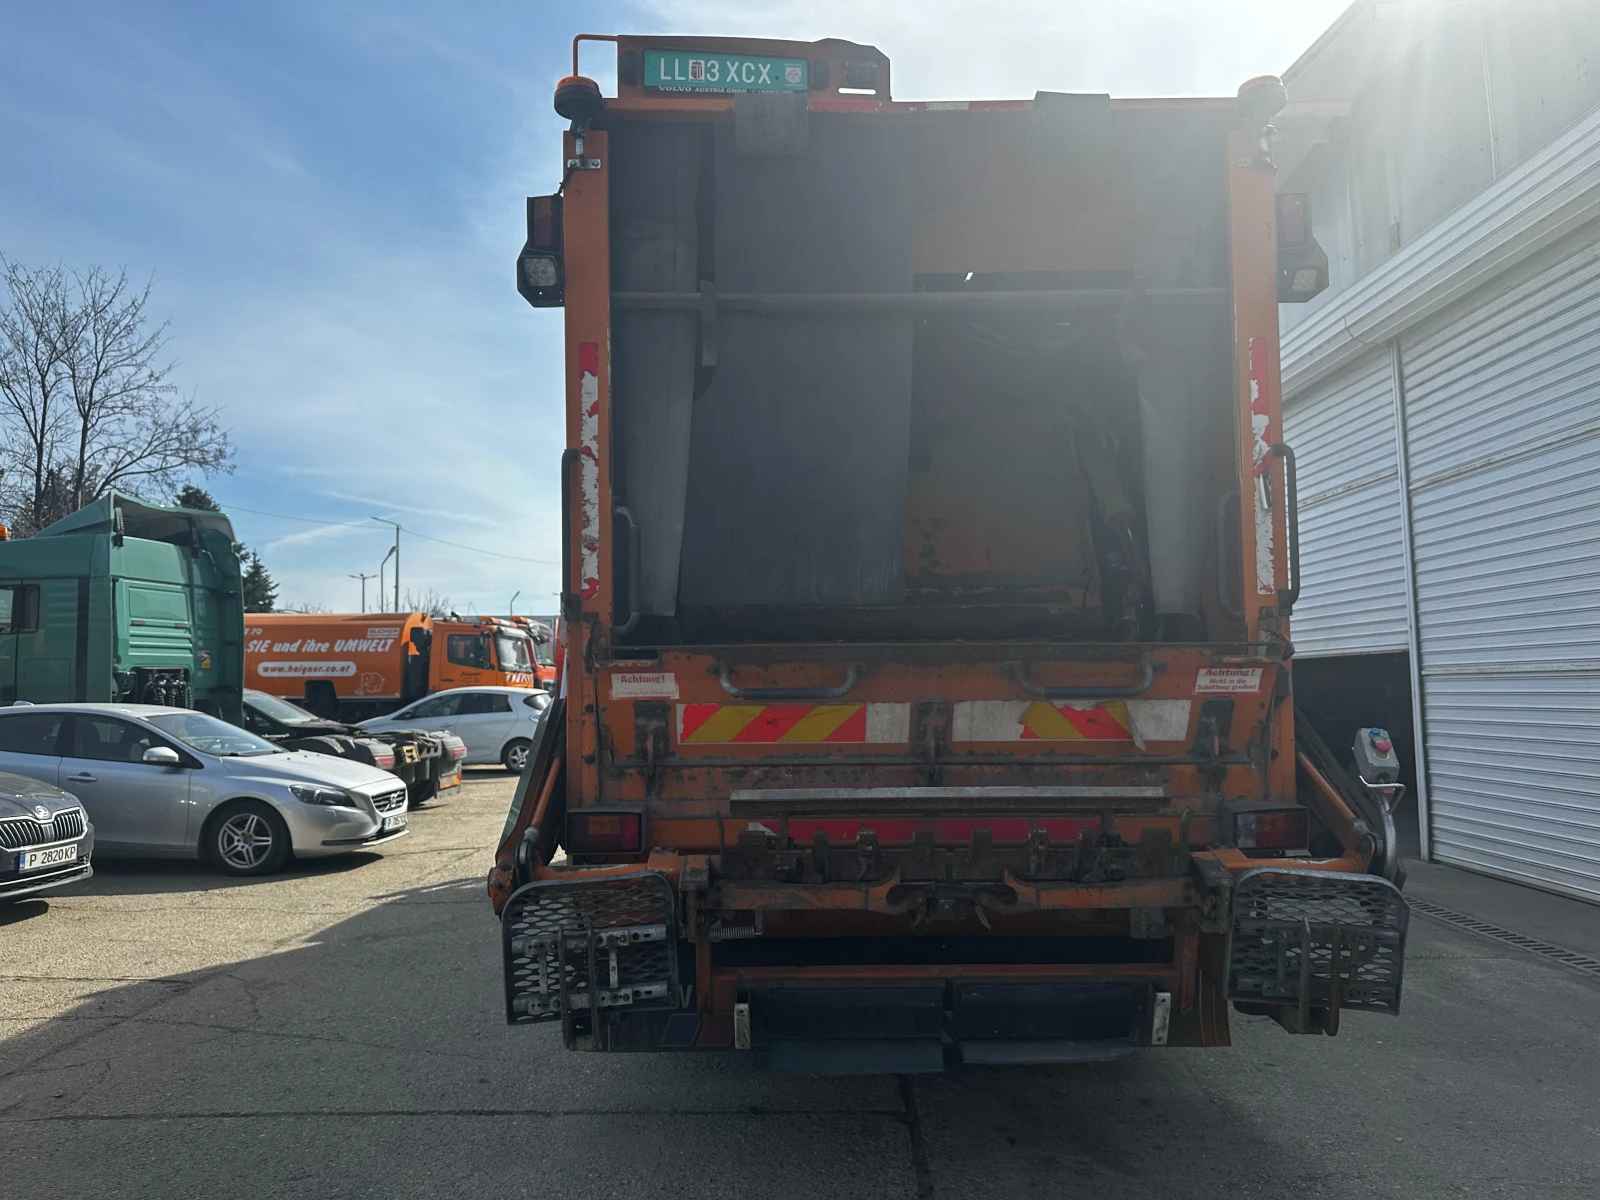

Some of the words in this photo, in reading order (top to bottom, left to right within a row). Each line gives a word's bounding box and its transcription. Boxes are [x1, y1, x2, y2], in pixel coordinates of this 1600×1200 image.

[660, 58, 686, 80] LL
[246, 639, 271, 653] SIE
[272, 640, 301, 653] und
[301, 639, 330, 653] ihre
[333, 639, 394, 653] UMWELT
[262, 664, 351, 675] www.haigner.co.at
[29, 853, 37, 867] P
